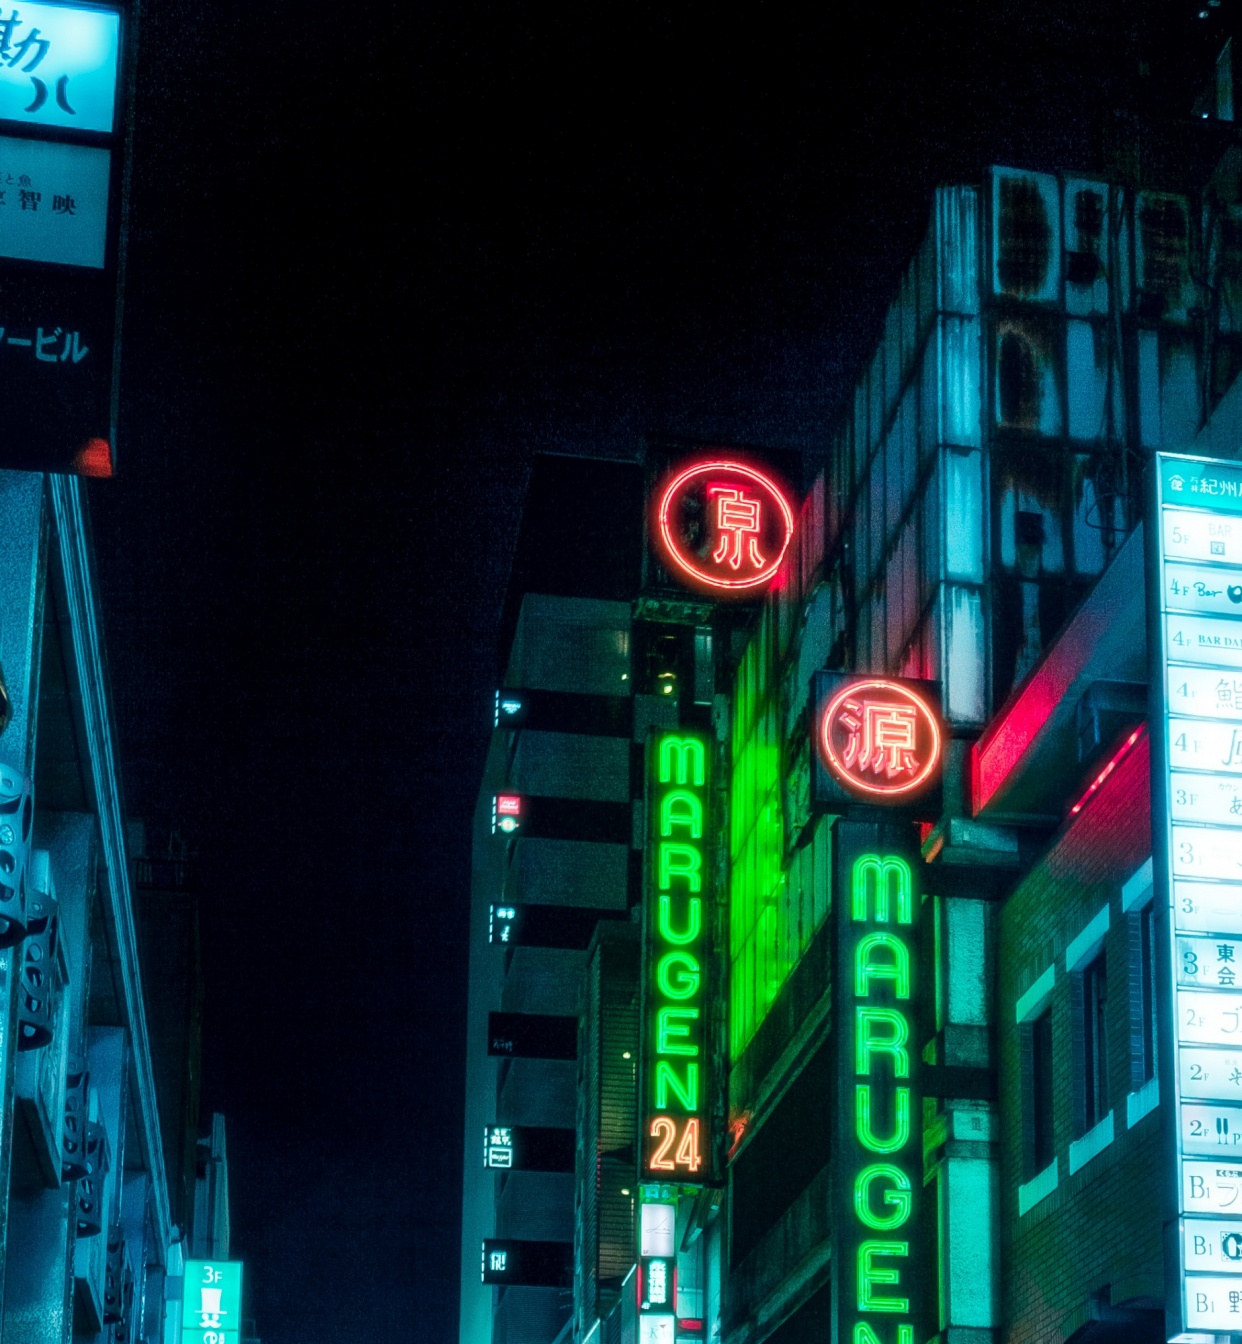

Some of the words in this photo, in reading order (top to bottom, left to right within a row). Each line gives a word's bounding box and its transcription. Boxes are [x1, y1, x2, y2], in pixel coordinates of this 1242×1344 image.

[0, 172, 32, 188] と魚
[0, 326, 89, 364] ービル
[1200, 479, 1242, 498] 紀州
[1172, 526, 1190, 545] 5F
[1170, 578, 1190, 597] 4F
[1172, 630, 1191, 647] 4F
[1198, 634, 1221, 646] BAR
[839, 698, 920, 778] 源
[1176, 789, 1198, 806] 3F
[1182, 898, 1200, 915] 3F
[656, 735, 705, 1110] MARUGEN
[1186, 1009, 1205, 1027] 2F
[1190, 1064, 1209, 1082] 2F
[1190, 1120, 1209, 1137] 2F
[650, 1115, 702, 1172] 24
[1190, 1176, 1210, 1199] B1
[1194, 1236, 1213, 1256] B1
[202, 1266, 223, 1284] 3F
[1196, 1293, 1214, 1312] B1
